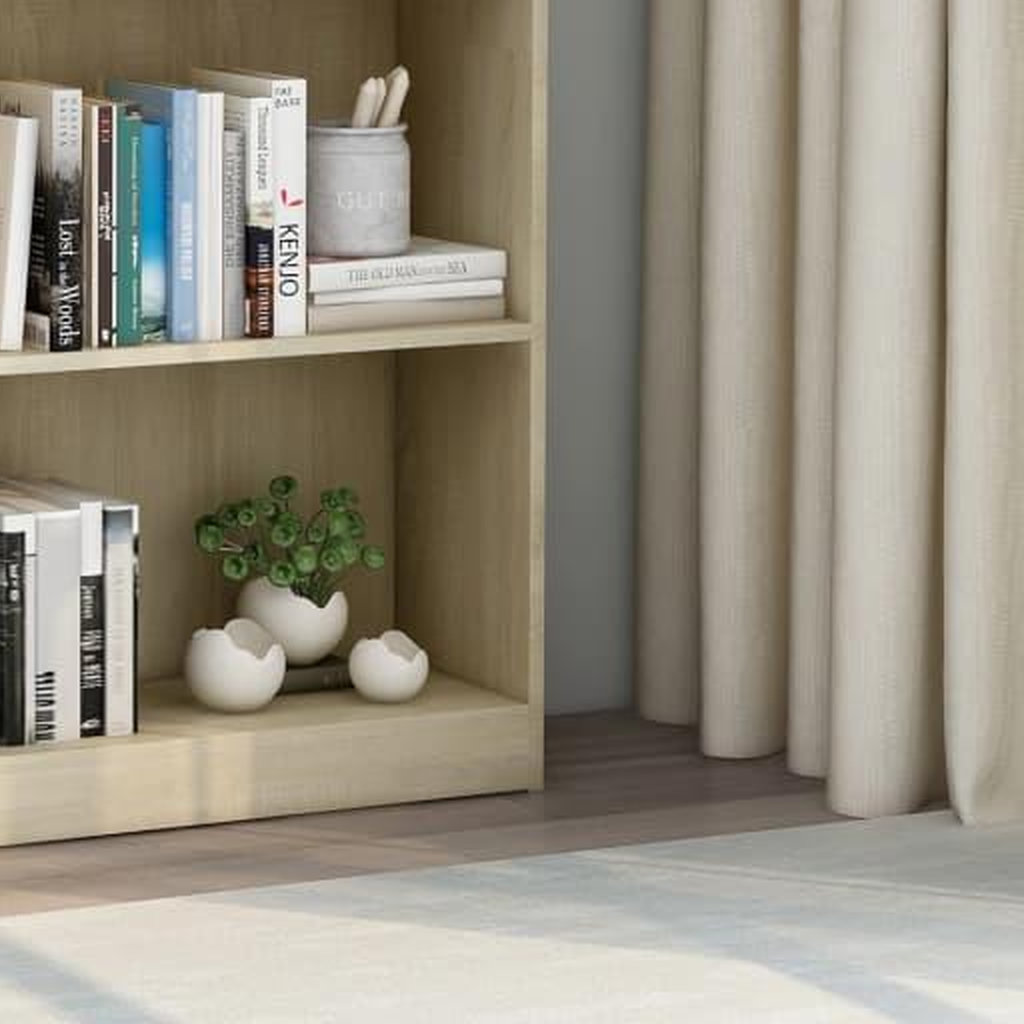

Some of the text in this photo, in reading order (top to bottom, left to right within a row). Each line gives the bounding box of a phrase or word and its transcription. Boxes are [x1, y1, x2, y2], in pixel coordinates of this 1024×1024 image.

[59, 219, 80, 258] Lost
[279, 224, 299, 298] KENJO
[59, 284, 80, 346] Woods
